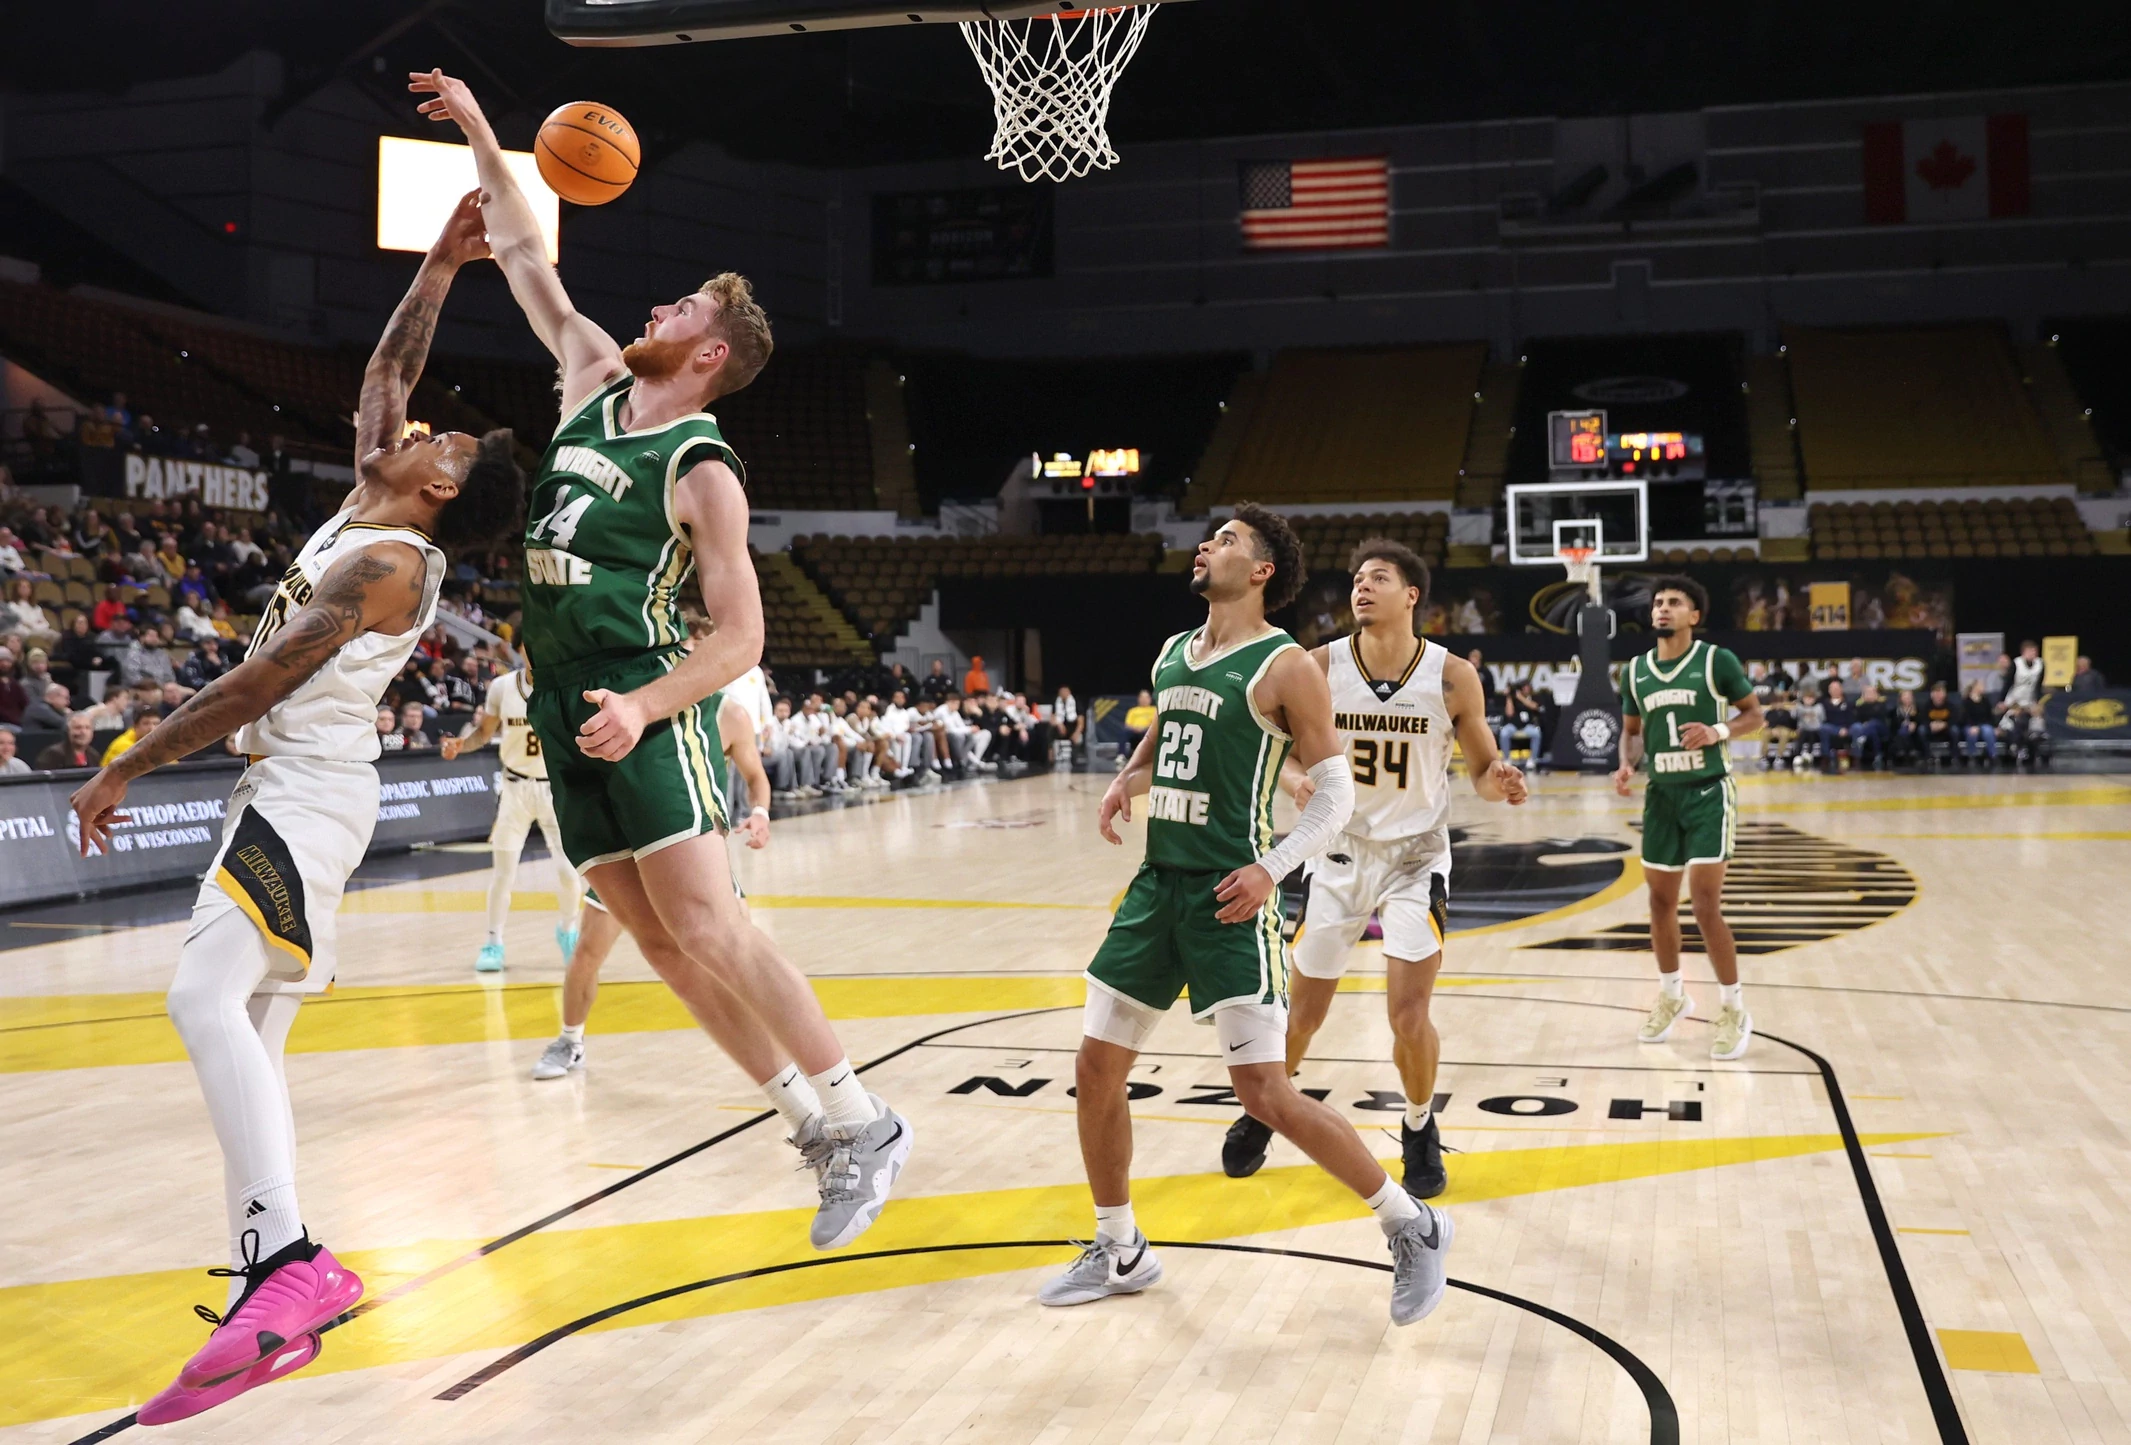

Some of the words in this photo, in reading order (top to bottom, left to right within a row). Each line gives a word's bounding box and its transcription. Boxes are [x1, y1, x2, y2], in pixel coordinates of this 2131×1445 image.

[126, 453, 270, 512] PANTHERS
[552, 445, 634, 504] WRIGHT
[531, 484, 595, 550] 14
[1157, 685, 1224, 721] WRIGHT
[1643, 688, 1697, 712] WRIGHT
[1334, 712, 1429, 735] MILWAUKEE
[1666, 711, 1681, 748] 1
[526, 730, 539, 757] 8
[1156, 721, 1203, 781] 23
[1654, 749, 1706, 773] STATE
[1353, 739, 1410, 790] 34
[380, 780, 431, 801] OPAEDIC
[430, 775, 489, 797] HOSPITAL
[1148, 785, 1210, 826] STATE
[0, 815, 55, 841] PITAL
[378, 803, 421, 821] SCONSIN
[113, 835, 133, 852] OF
[134, 825, 212, 849] WISCONSIN
[236, 844, 296, 933] MILWAUKEE
